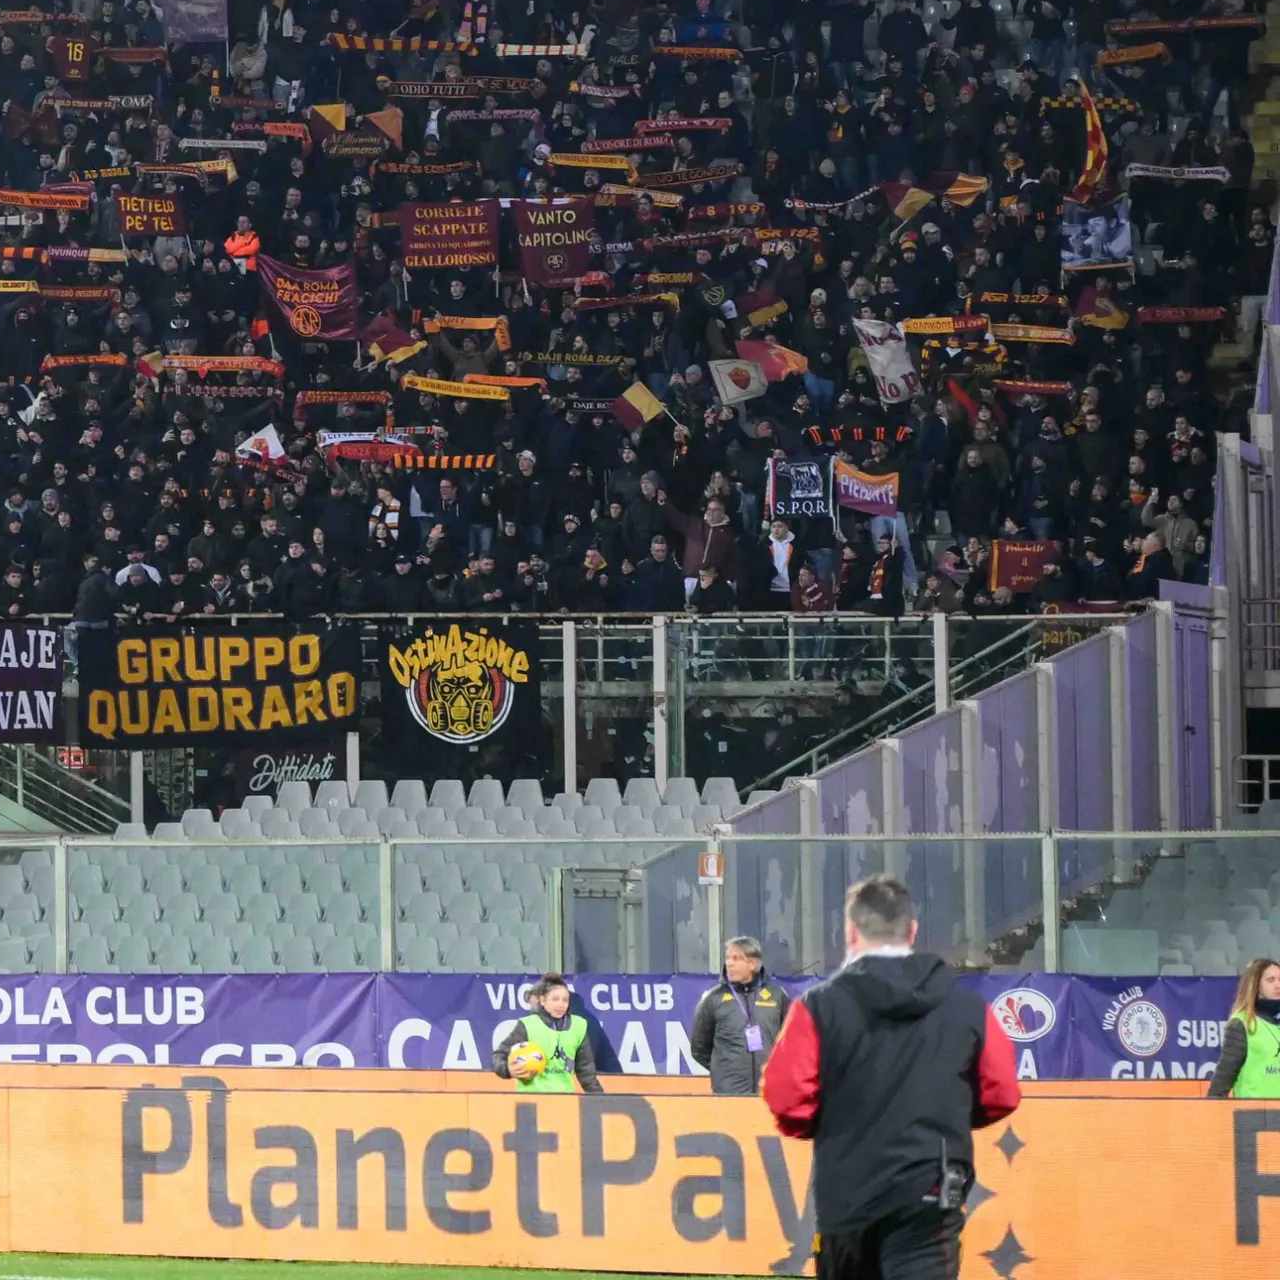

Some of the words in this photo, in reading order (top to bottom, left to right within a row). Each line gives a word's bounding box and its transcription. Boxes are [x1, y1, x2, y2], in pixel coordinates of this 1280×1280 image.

[66, 41, 84, 63] 16
[399, 83, 429, 96] ODIO
[431, 83, 465, 96] TUTTI
[414, 205, 484, 220] CORRETE
[526, 210, 577, 225] VANTO
[125, 214, 147, 232] PE'
[152, 214, 174, 232] TE!
[412, 221, 488, 237] SCAPPATE
[607, 241, 634, 253] ROMA
[404, 251, 496, 267] GIALLOROSSO
[302, 279, 340, 291] ROMA
[979, 292, 1009, 304] ASR
[1013, 293, 1049, 305] 1927
[537, 352, 563, 363] DAJE
[564, 353, 594, 364] ROMA
[573, 400, 598, 410] DAJE
[840, 473, 895, 505] PIEMONTE
[776, 500, 830, 517] S.P.Q.R.
[116, 633, 322, 684] GRUPPO
[87, 671, 357, 741] QUADRARO
[485, 982, 576, 1011] VIOA
[590, 982, 675, 1011] CLUB
[84, 986, 206, 1025] CLUB
